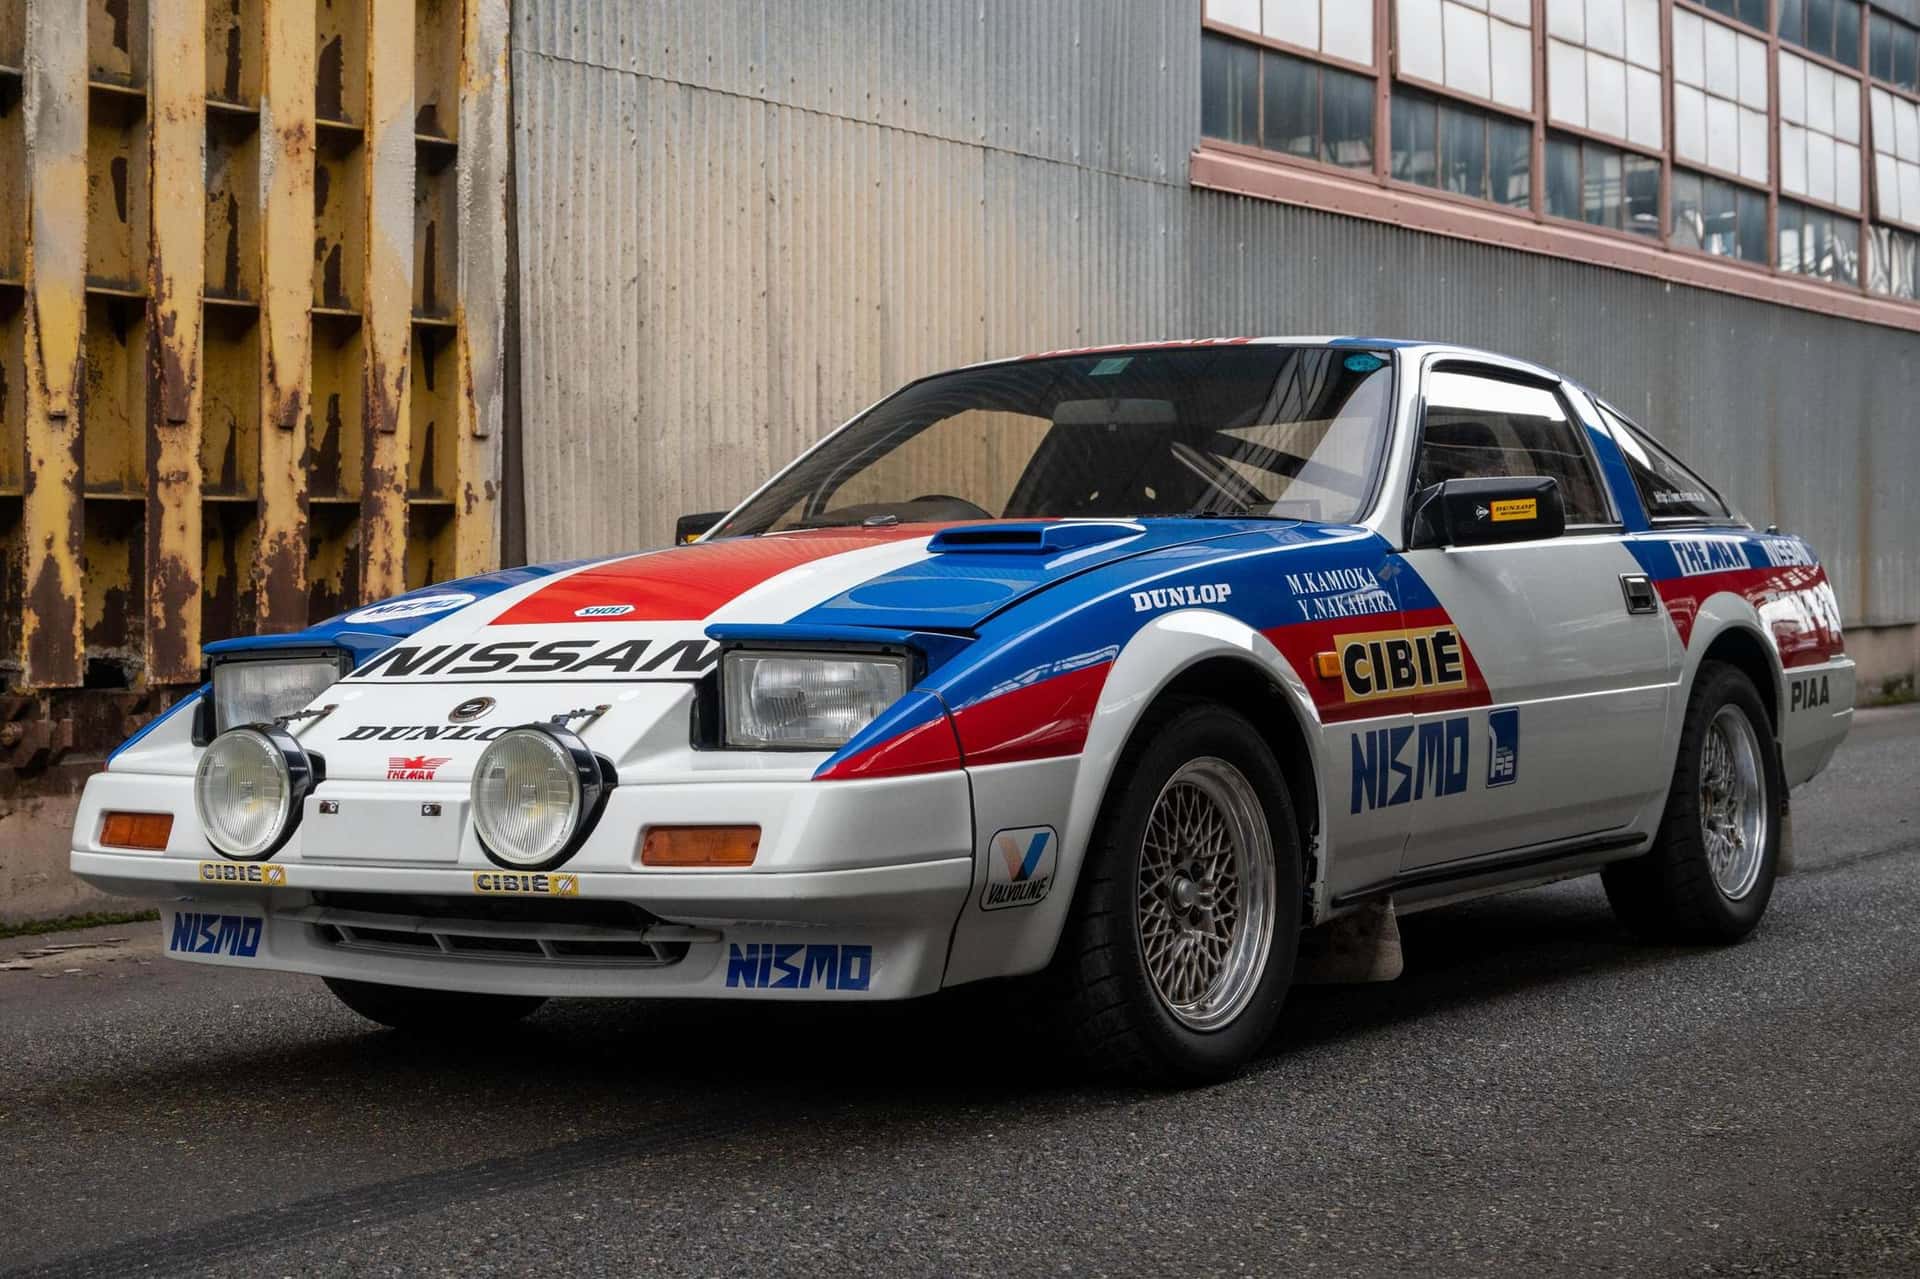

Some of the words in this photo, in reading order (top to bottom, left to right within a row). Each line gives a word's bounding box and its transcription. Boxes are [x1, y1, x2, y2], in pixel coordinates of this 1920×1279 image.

[1496, 504, 1536, 512] DUNLOP
[1285, 567, 1379, 595] M.KAMIOKA
[584, 606, 630, 614] SHOEI
[1130, 583, 1232, 612] DUNLOP
[1297, 592, 1397, 620] Y.NAKAHARA
[350, 639, 721, 677] NISSAN
[1791, 675, 1829, 712] PIAA
[1351, 716, 1469, 815] NISMO
[987, 877, 1048, 904] VALVOLINE
[170, 912, 263, 957] NISMO
[725, 943, 873, 991] NISMO
